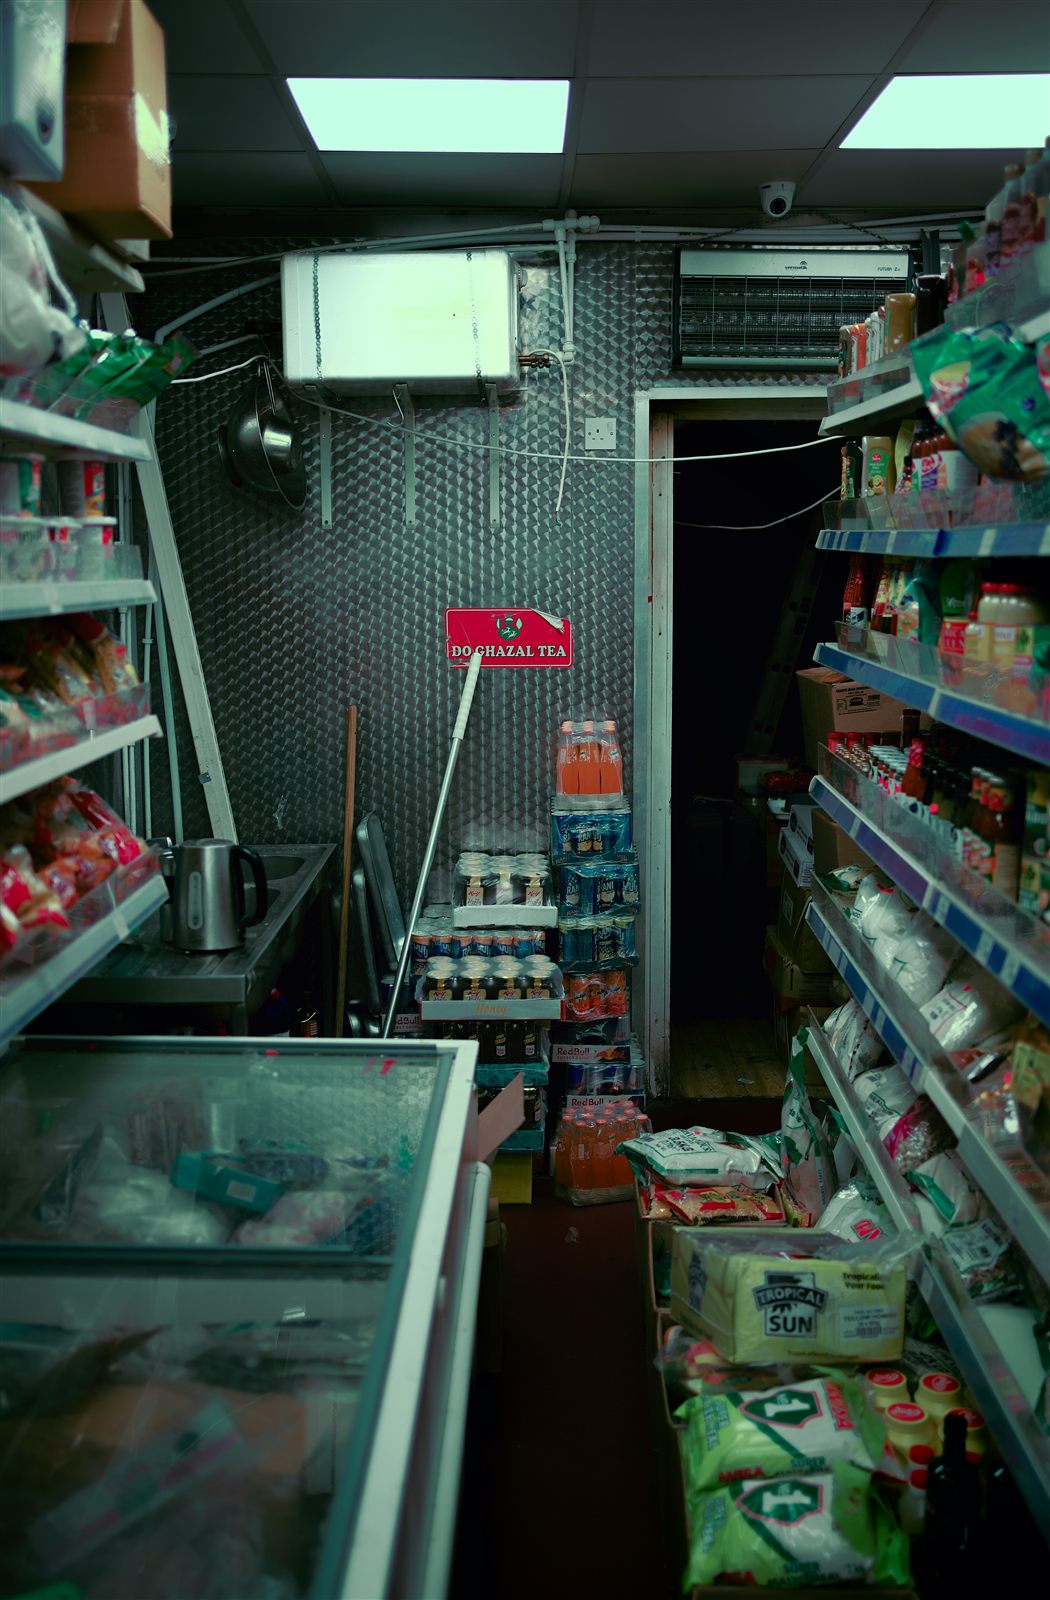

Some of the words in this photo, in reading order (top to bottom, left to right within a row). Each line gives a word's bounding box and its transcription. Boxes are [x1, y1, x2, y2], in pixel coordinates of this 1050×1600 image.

[451, 645, 472, 657] DO
[475, 645, 534, 657] GHAZAL
[537, 645, 567, 657] TEA
[757, 1286, 823, 1307] TROPICAL
[769, 1315, 813, 1333] SUN
